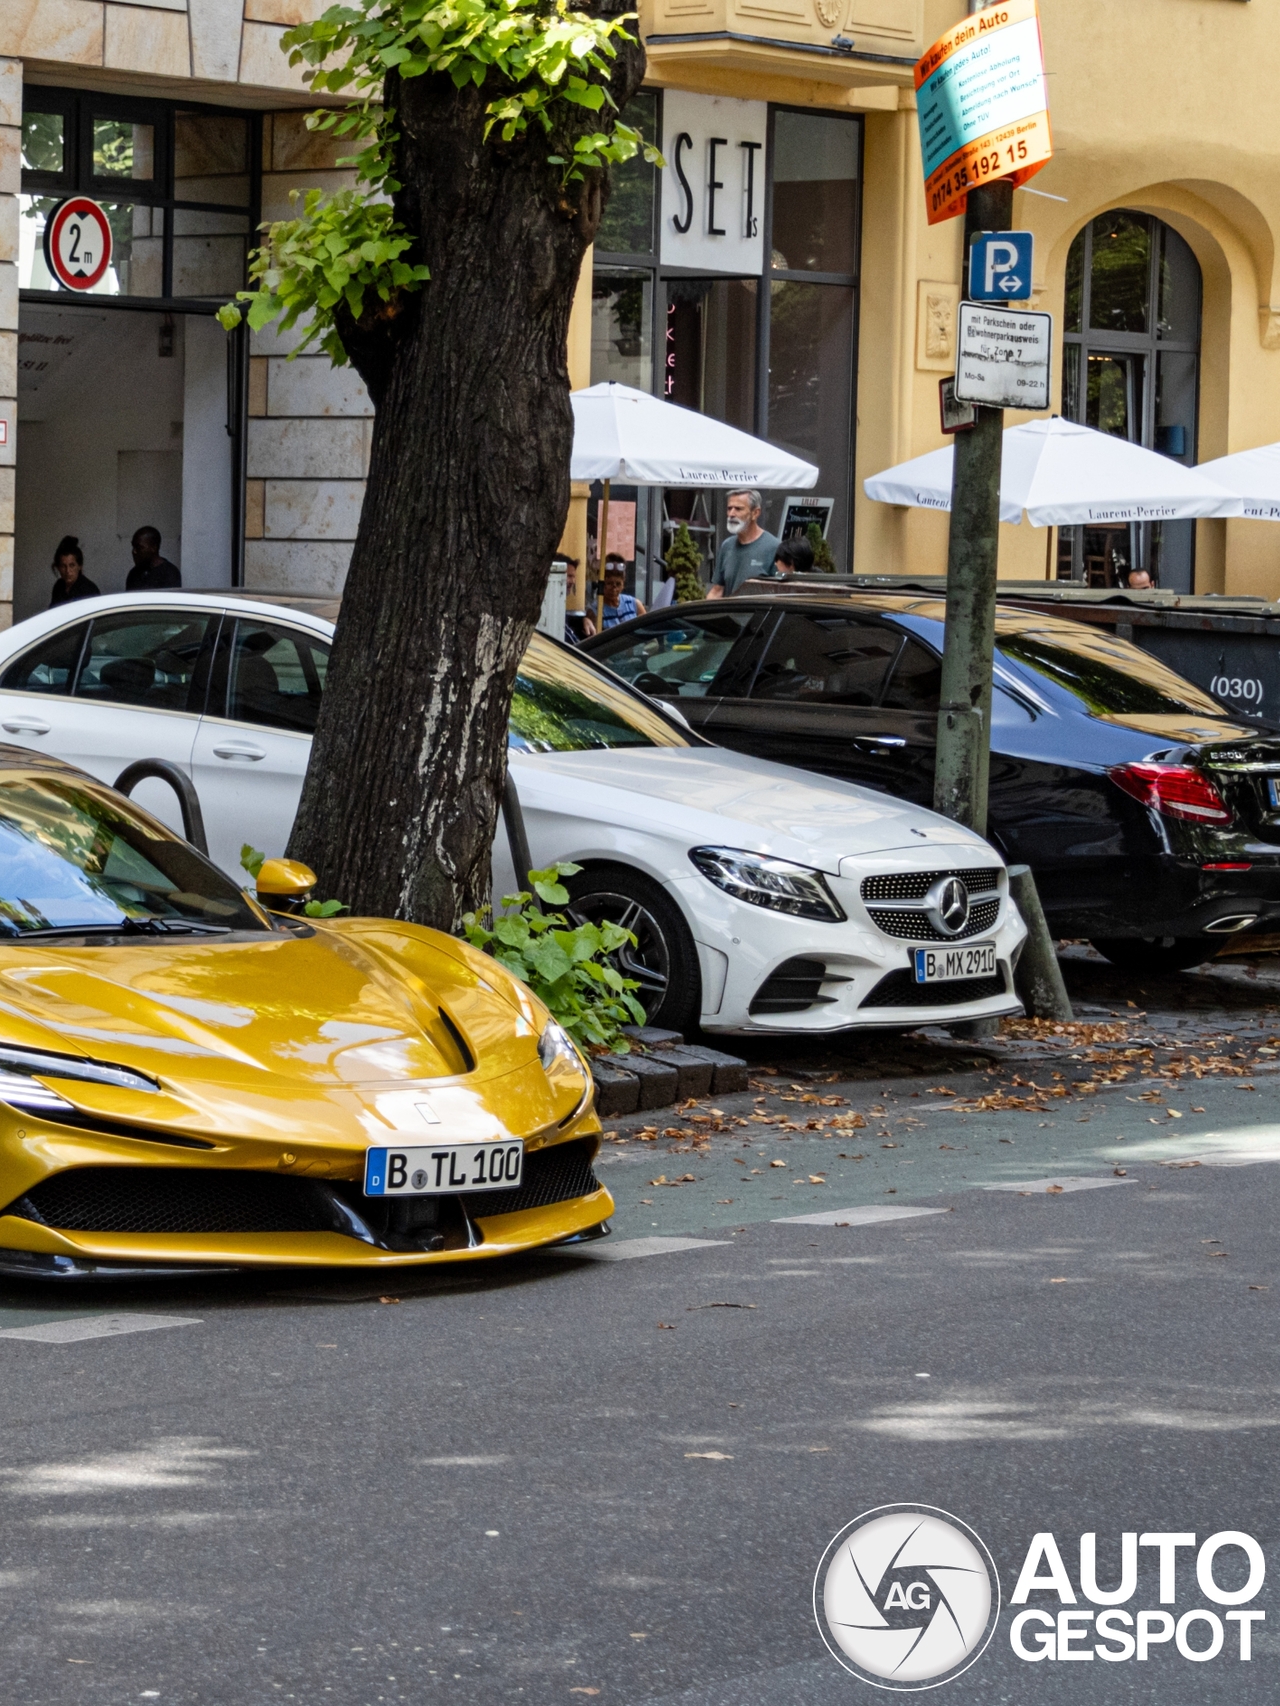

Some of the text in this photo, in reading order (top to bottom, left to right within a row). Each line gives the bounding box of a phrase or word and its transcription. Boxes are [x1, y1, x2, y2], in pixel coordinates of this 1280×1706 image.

[930, 40, 953, 67] kaufen
[954, 25, 975, 46] dein
[979, 11, 1009, 33] Auto
[937, 67, 953, 85] kaufen
[953, 56, 970, 75] jedes
[971, 43, 991, 60] Auto!
[958, 54, 1021, 88] Kostenlose Abholung
[959, 68, 1020, 103] Besichtigung vor Ort
[961, 78, 1038, 117] Abmeldung nach Wunsch
[962, 118, 977, 131] Ohne
[980, 139, 991, 150] 143
[995, 129, 1015, 143] 12439
[1016, 121, 1037, 136] Berlin
[932, 181, 952, 212] 0174
[954, 167, 968, 191] 35
[972, 151, 1000, 179] 192
[1006, 140, 1028, 164] 15
[69, 223, 93, 264] 2 m
[984, 241, 1019, 292] P
[967, 325, 1040, 345] Bewohnerparkausweis
[971, 314, 1036, 332] mit Parkschein oder
[1017, 349, 1023, 359] 7
[964, 371, 986, 382] Mo-Sa
[1016, 378, 1045, 388] 09-22 h
[679, 467, 759, 482] Laurent-Perrier
[1088, 505, 1177, 520] Laurent-Perrier
[1210, 675, 1264, 705] (030)
[926, 953, 936, 977] B
[946, 951, 964, 976] MX
[966, 948, 995, 975] 2910
[371, 1146, 520, 1189] D B TL 100
